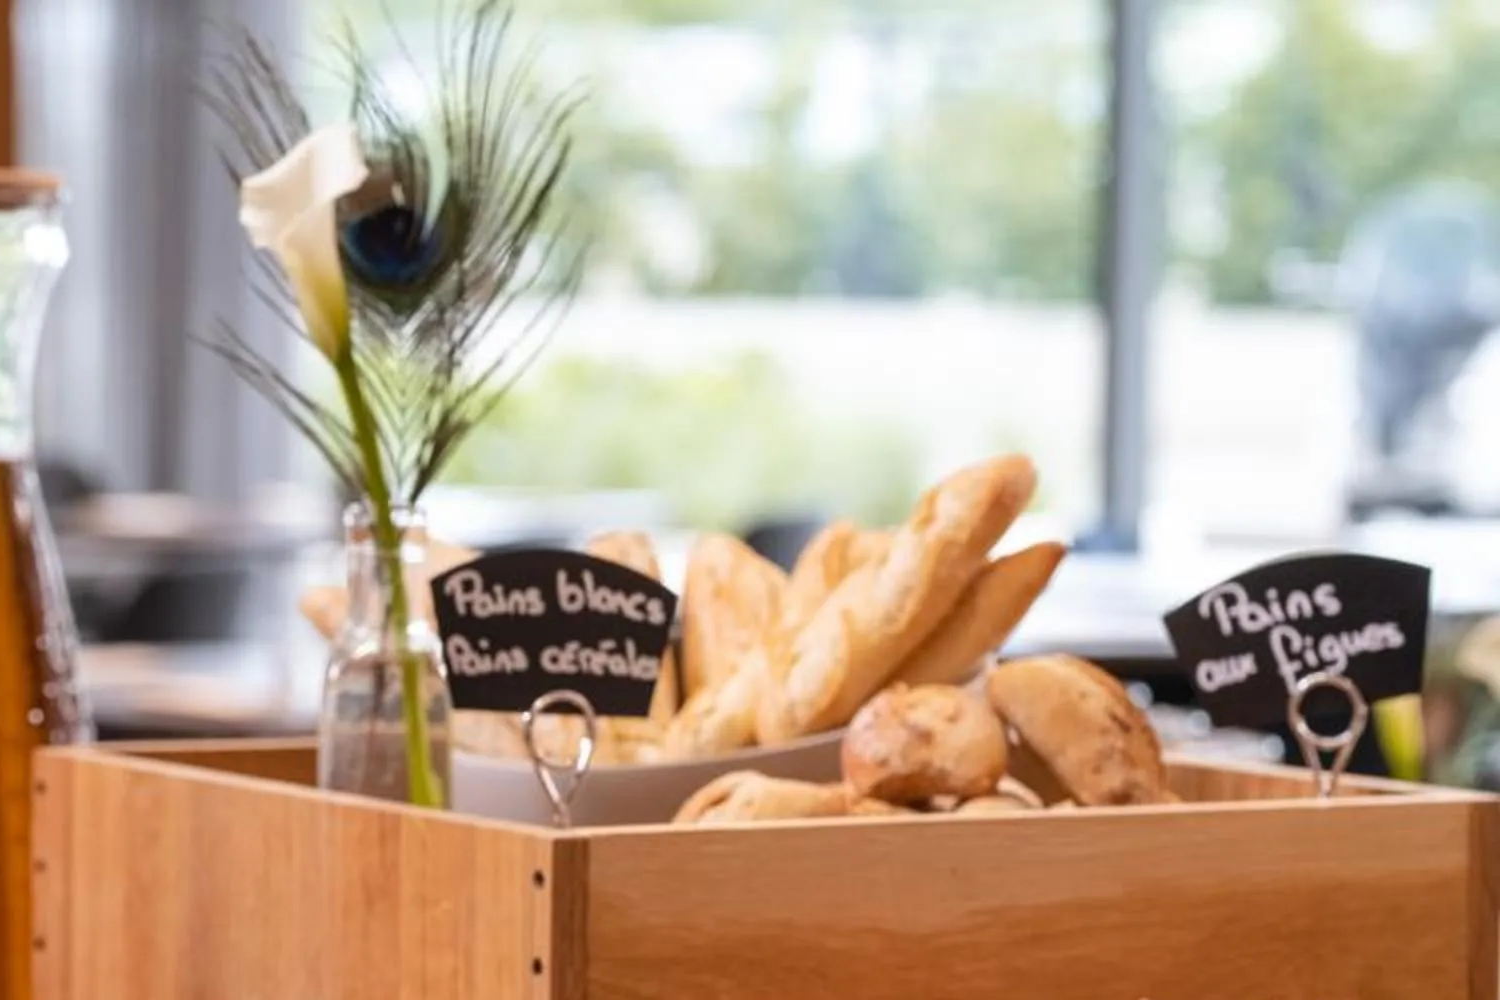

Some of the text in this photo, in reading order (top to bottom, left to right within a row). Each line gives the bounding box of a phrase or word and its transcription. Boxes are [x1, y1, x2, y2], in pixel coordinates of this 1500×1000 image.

[444, 568, 666, 626] Pains blancs
[1198, 581, 1343, 637] Pains
[445, 633, 529, 677] Pains
[1268, 622, 1406, 698] figues
